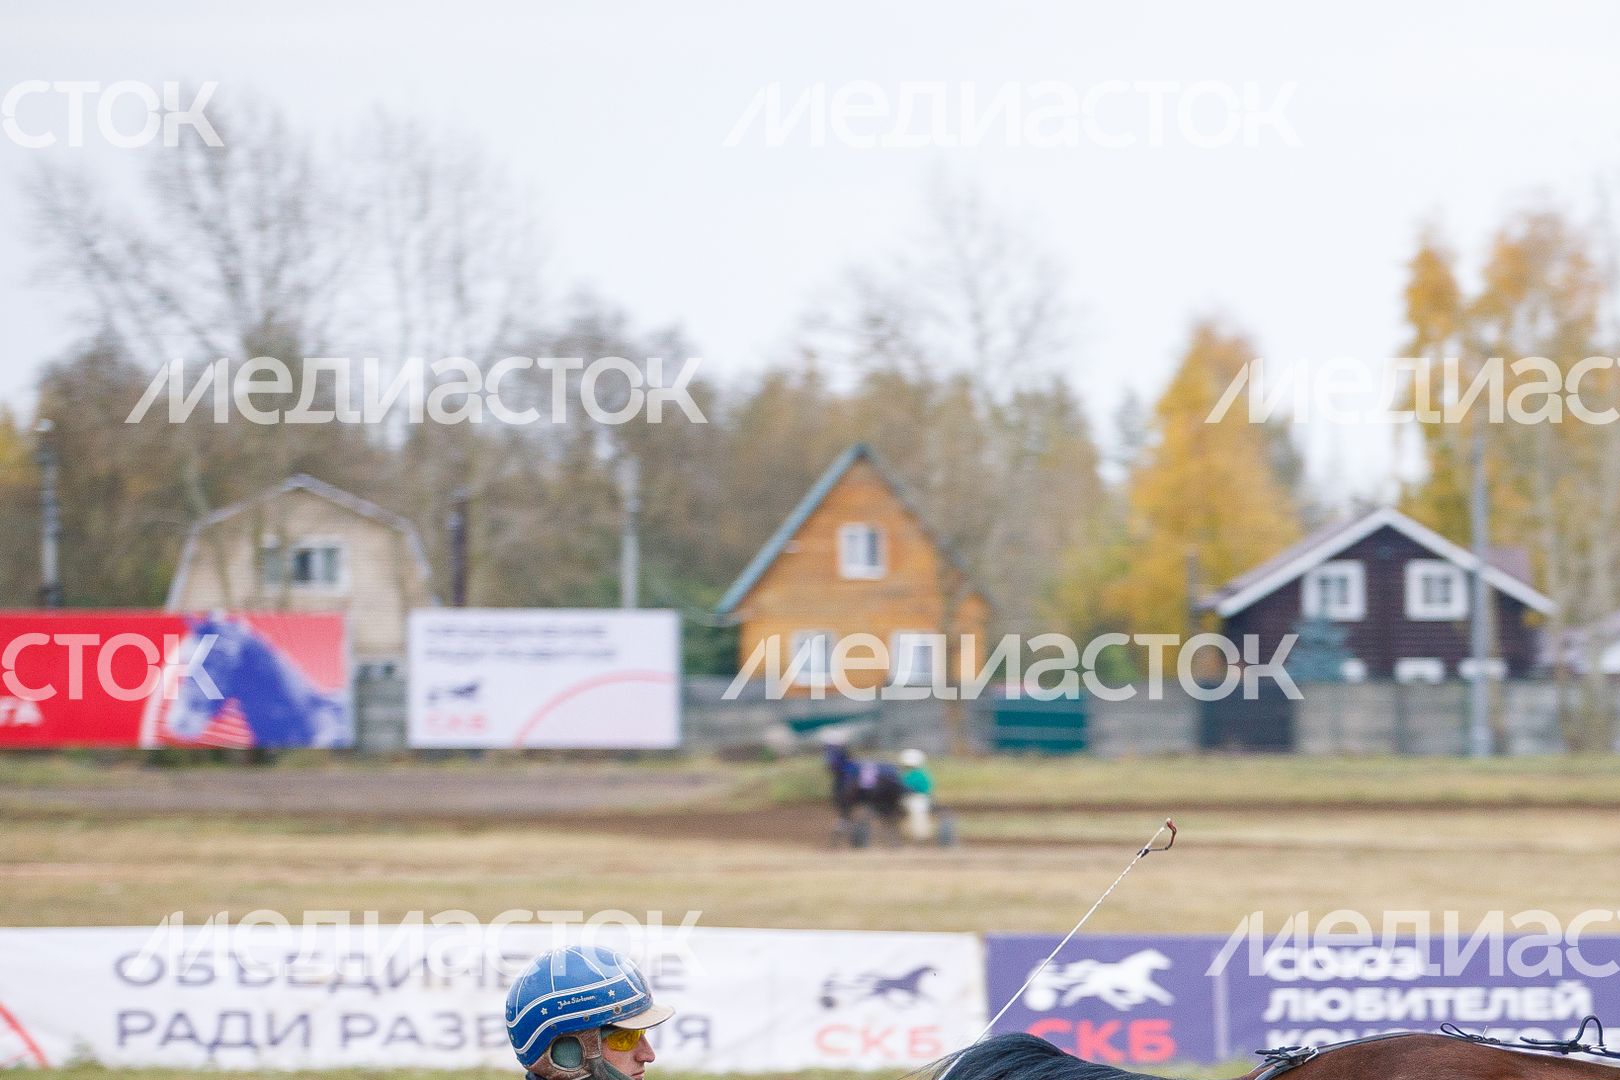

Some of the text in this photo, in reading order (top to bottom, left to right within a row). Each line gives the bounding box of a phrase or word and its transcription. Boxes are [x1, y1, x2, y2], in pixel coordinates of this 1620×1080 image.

[1263, 980, 1595, 1024] ЛЮБИТЕЛЕЙ
[116, 1009, 312, 1060] РАДИ
[814, 1023, 944, 1060] СКБ
